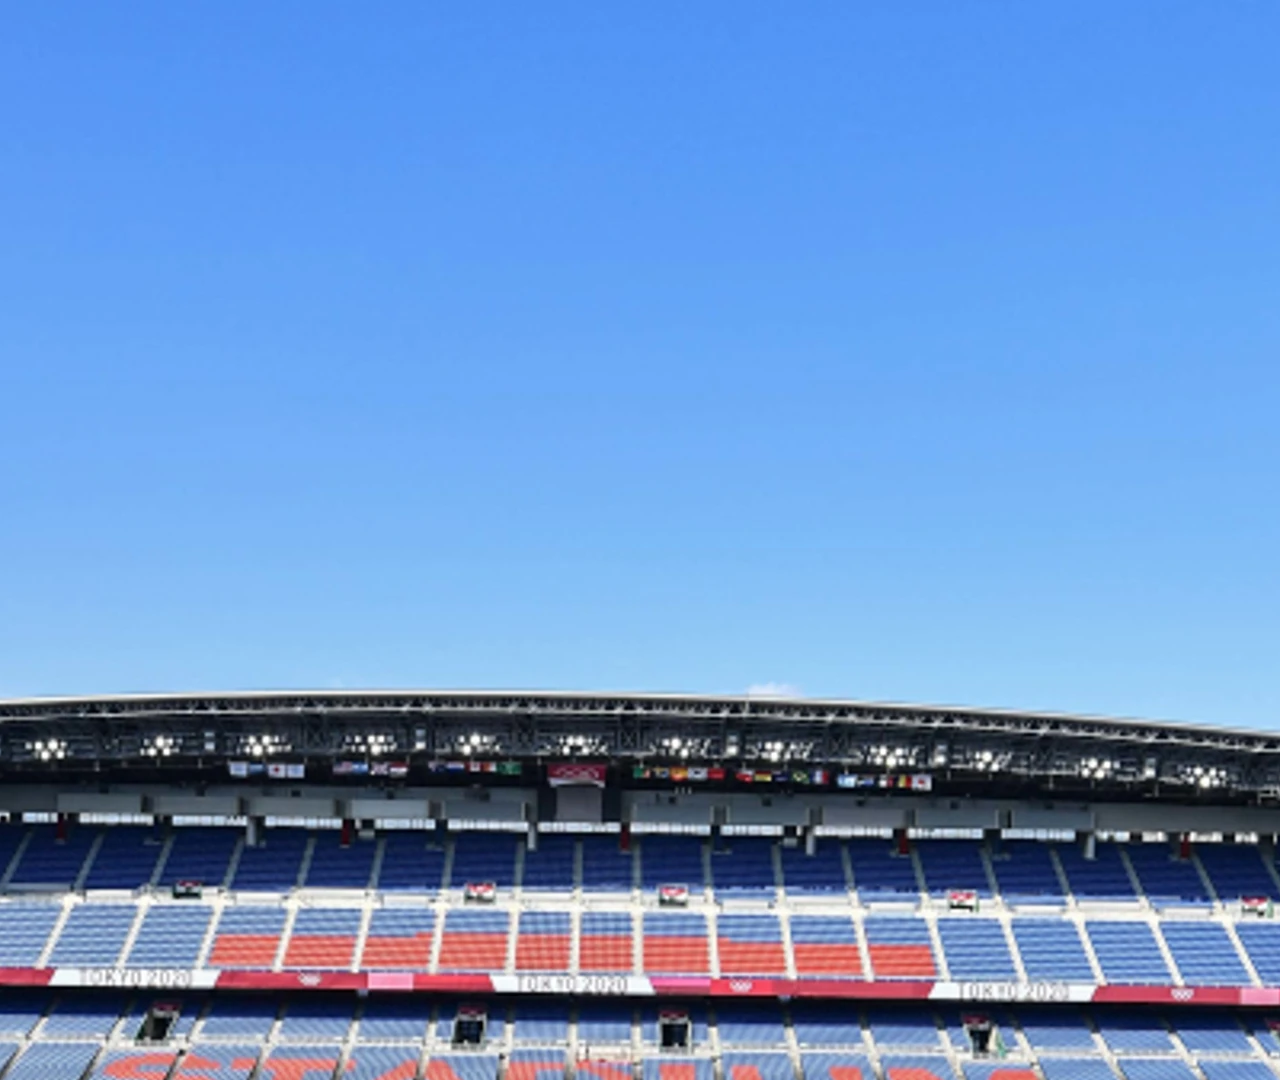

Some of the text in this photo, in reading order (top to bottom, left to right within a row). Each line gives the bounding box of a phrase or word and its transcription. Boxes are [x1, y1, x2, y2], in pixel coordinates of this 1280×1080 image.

[145, 969, 193, 987] 2020
[583, 975, 628, 995] 2020
[1023, 983, 1070, 1001] 2020
